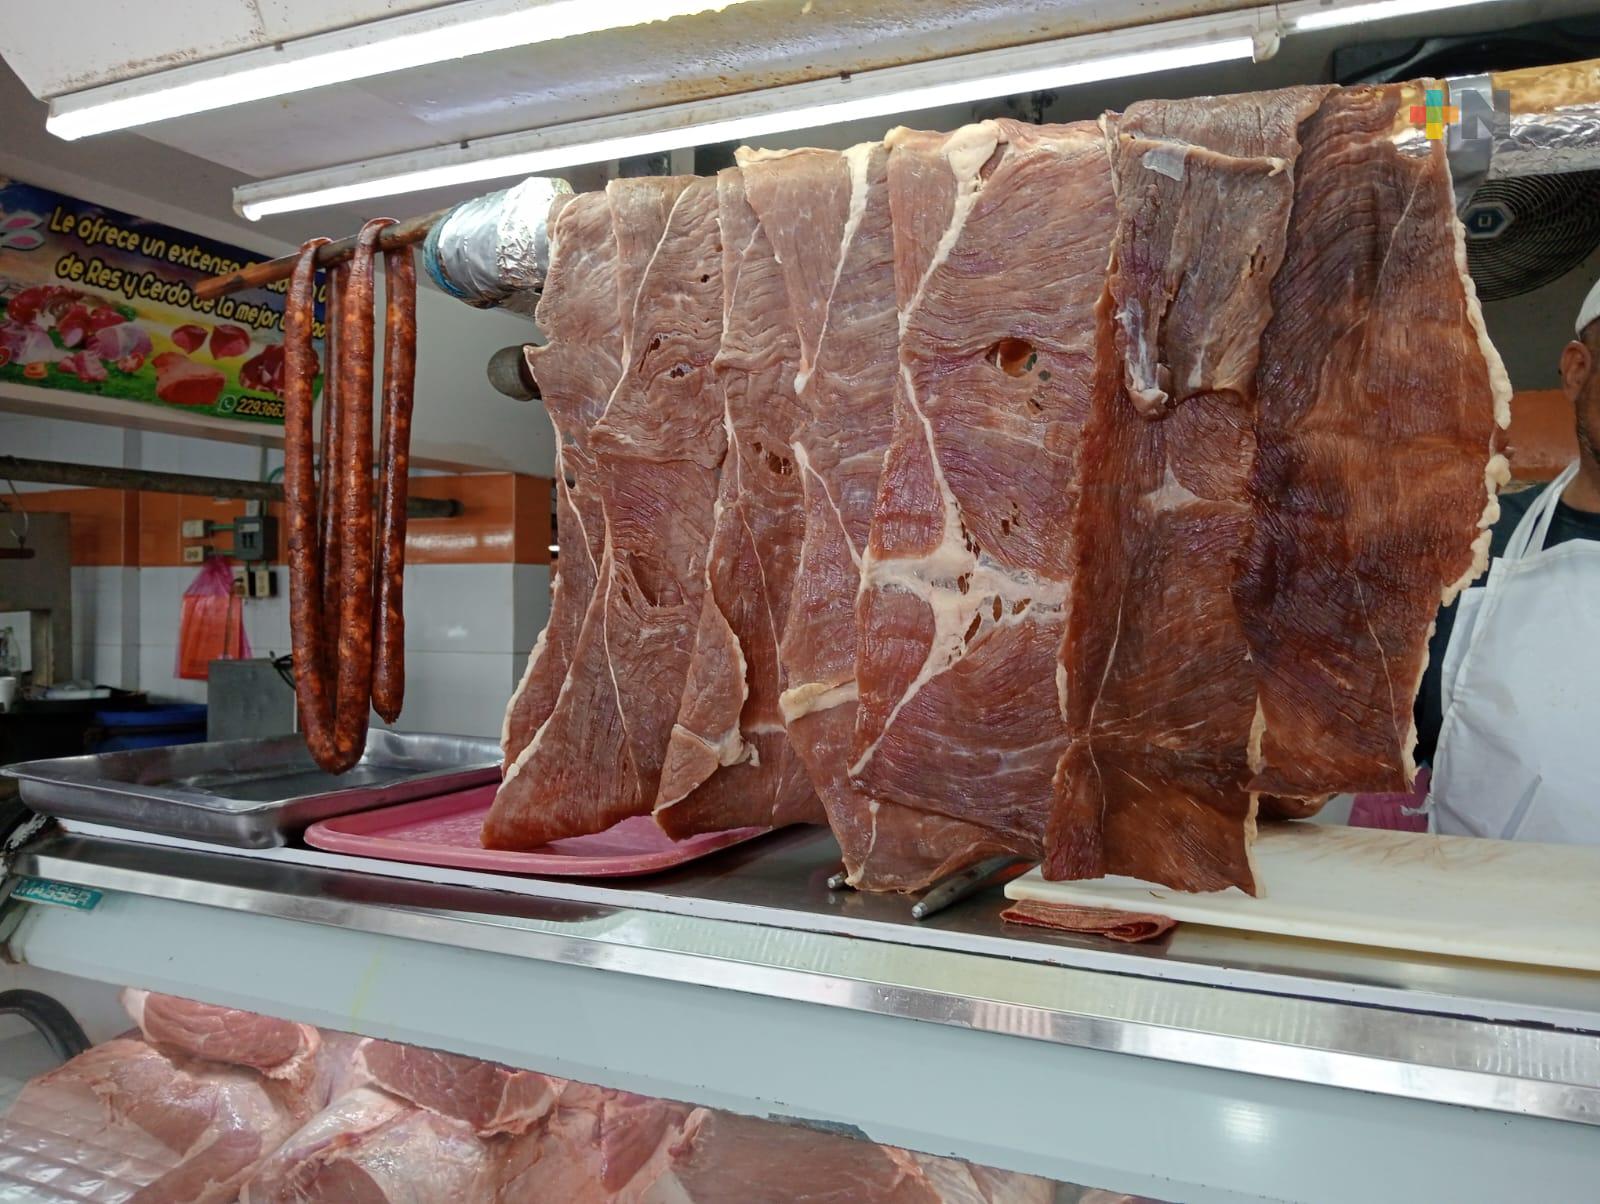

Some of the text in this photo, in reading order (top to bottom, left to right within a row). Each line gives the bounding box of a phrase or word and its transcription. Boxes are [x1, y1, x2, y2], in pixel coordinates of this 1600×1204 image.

[50, 205, 76, 233] Le
[78, 217, 140, 250] ofrece
[142, 236, 166, 259] un
[57, 254, 84, 279] de
[86, 259, 122, 289] Res
[123, 274, 138, 298] y
[139, 273, 191, 304] Cerdo
[217, 295, 233, 319] la
[235, 302, 279, 330] mejor
